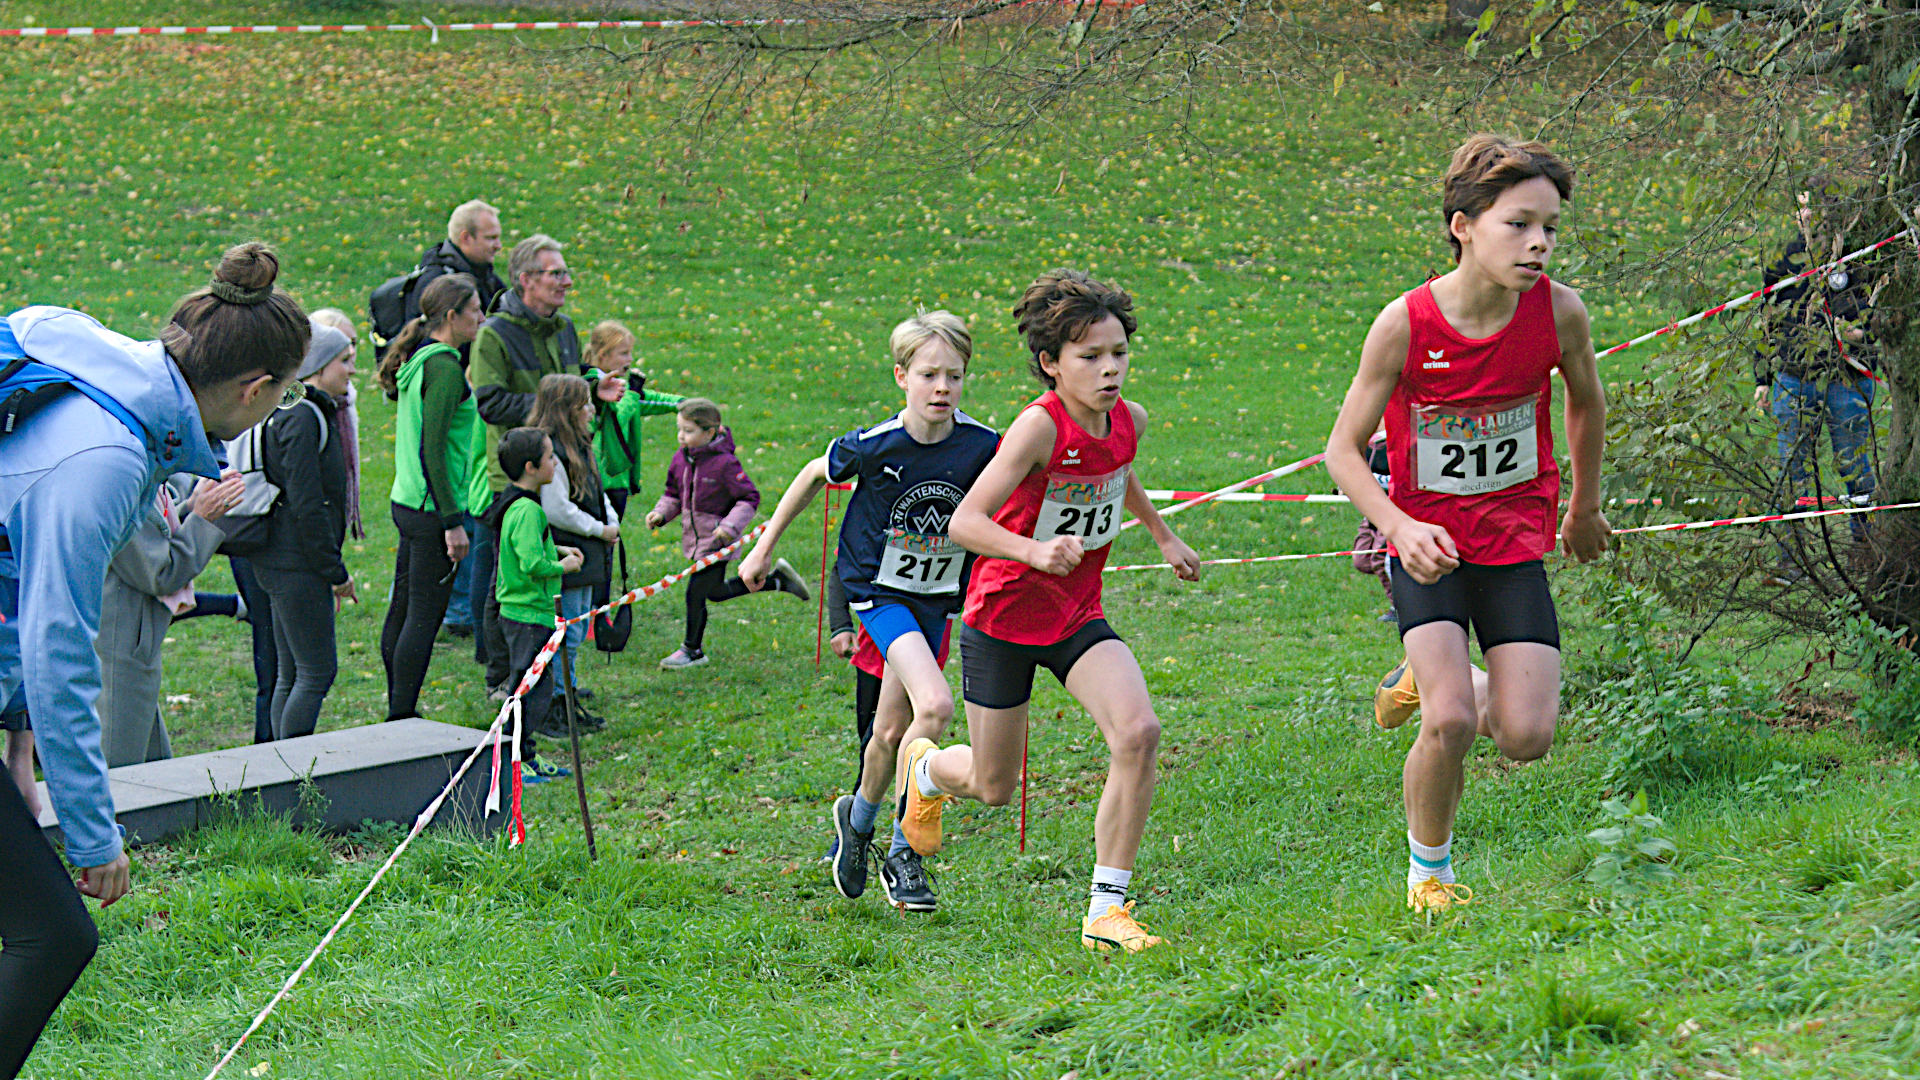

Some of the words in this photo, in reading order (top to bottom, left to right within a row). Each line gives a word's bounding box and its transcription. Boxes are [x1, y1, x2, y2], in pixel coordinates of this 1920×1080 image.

[1423, 360, 1450, 369] erima
[1478, 403, 1531, 430] LAUFEN
[1441, 438, 1518, 479] 212
[1054, 503, 1113, 537] 213
[895, 554, 952, 582] 217
